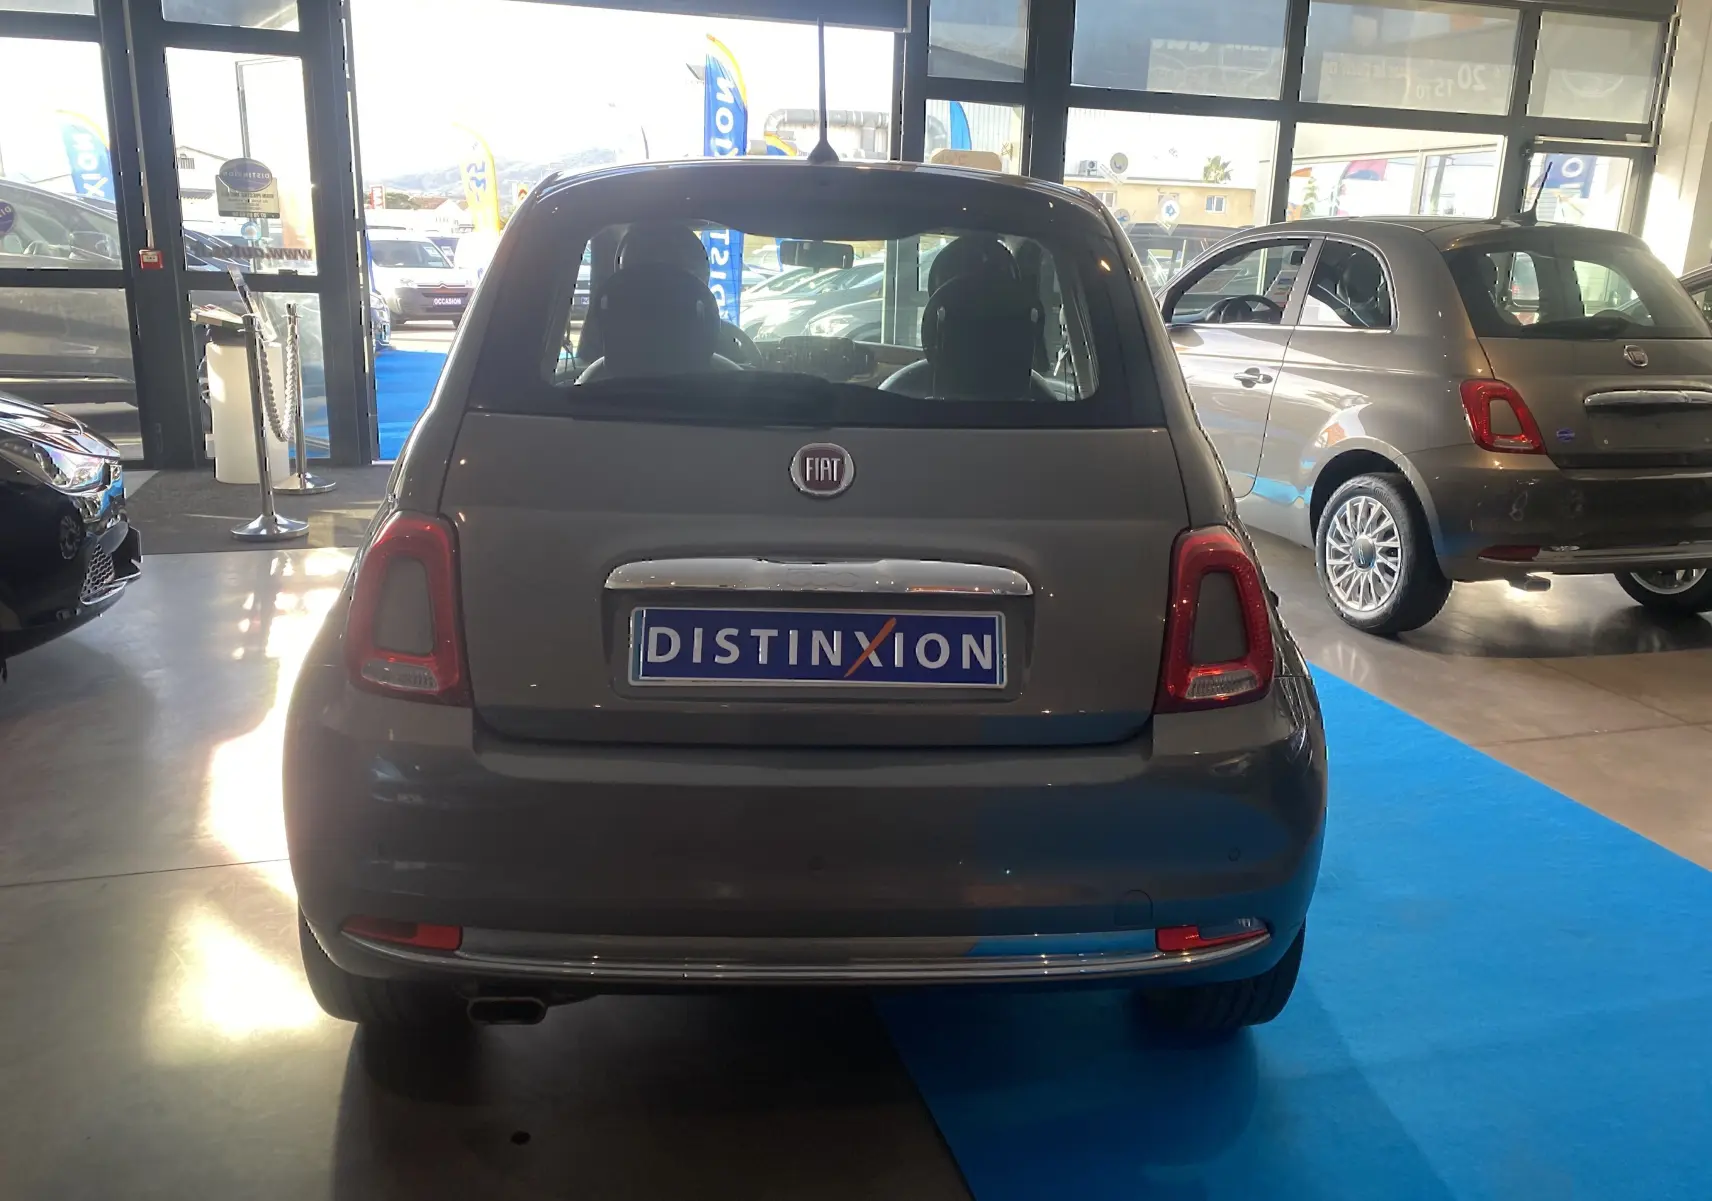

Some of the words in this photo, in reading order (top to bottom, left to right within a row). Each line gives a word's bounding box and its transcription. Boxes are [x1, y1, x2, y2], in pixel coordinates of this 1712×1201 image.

[433, 297, 461, 305] OCCASION
[805, 456, 841, 482] FIAT
[646, 616, 993, 678] DISTINXION
